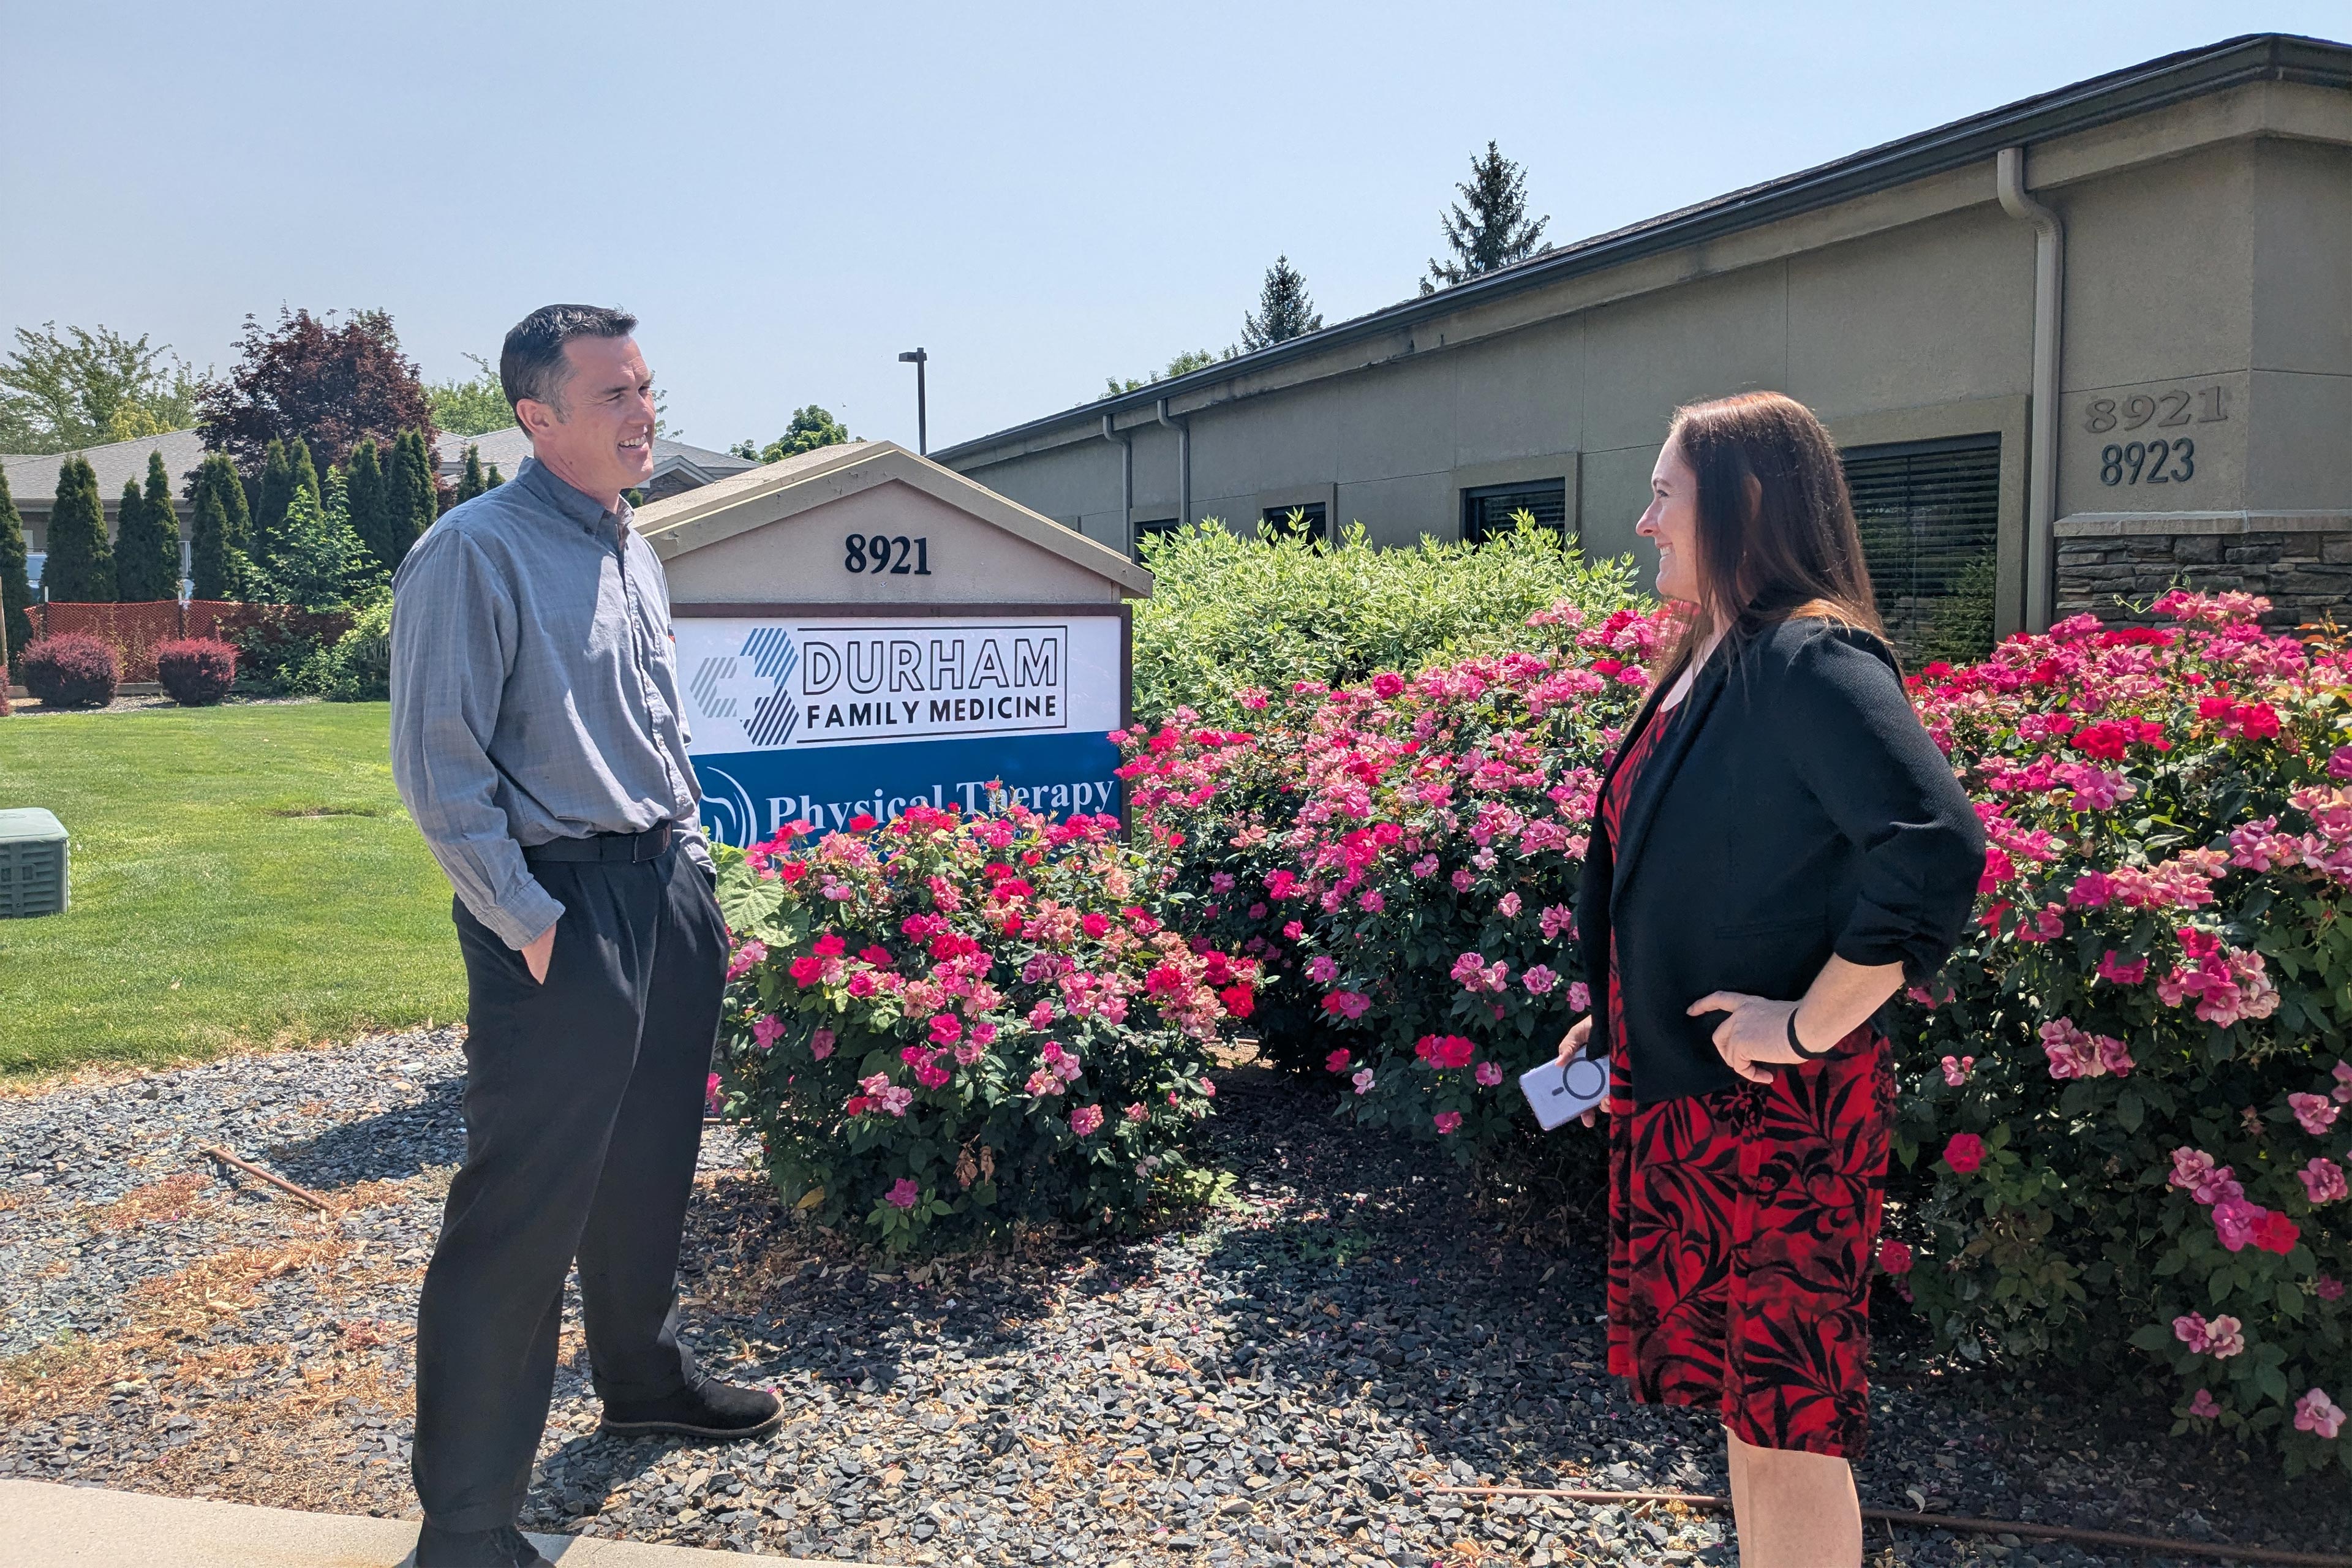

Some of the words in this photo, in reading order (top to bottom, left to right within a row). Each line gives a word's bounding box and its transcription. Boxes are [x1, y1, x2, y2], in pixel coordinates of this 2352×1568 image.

[2084, 385, 2228, 433] 8921
[2100, 437, 2195, 486] 8923
[845, 533, 932, 575] 8921
[803, 638, 1057, 695] DURHAM
[807, 700, 920, 729] FAMILY
[930, 695, 1057, 722] MEDICINE
[957, 780, 1114, 815] Therapy
